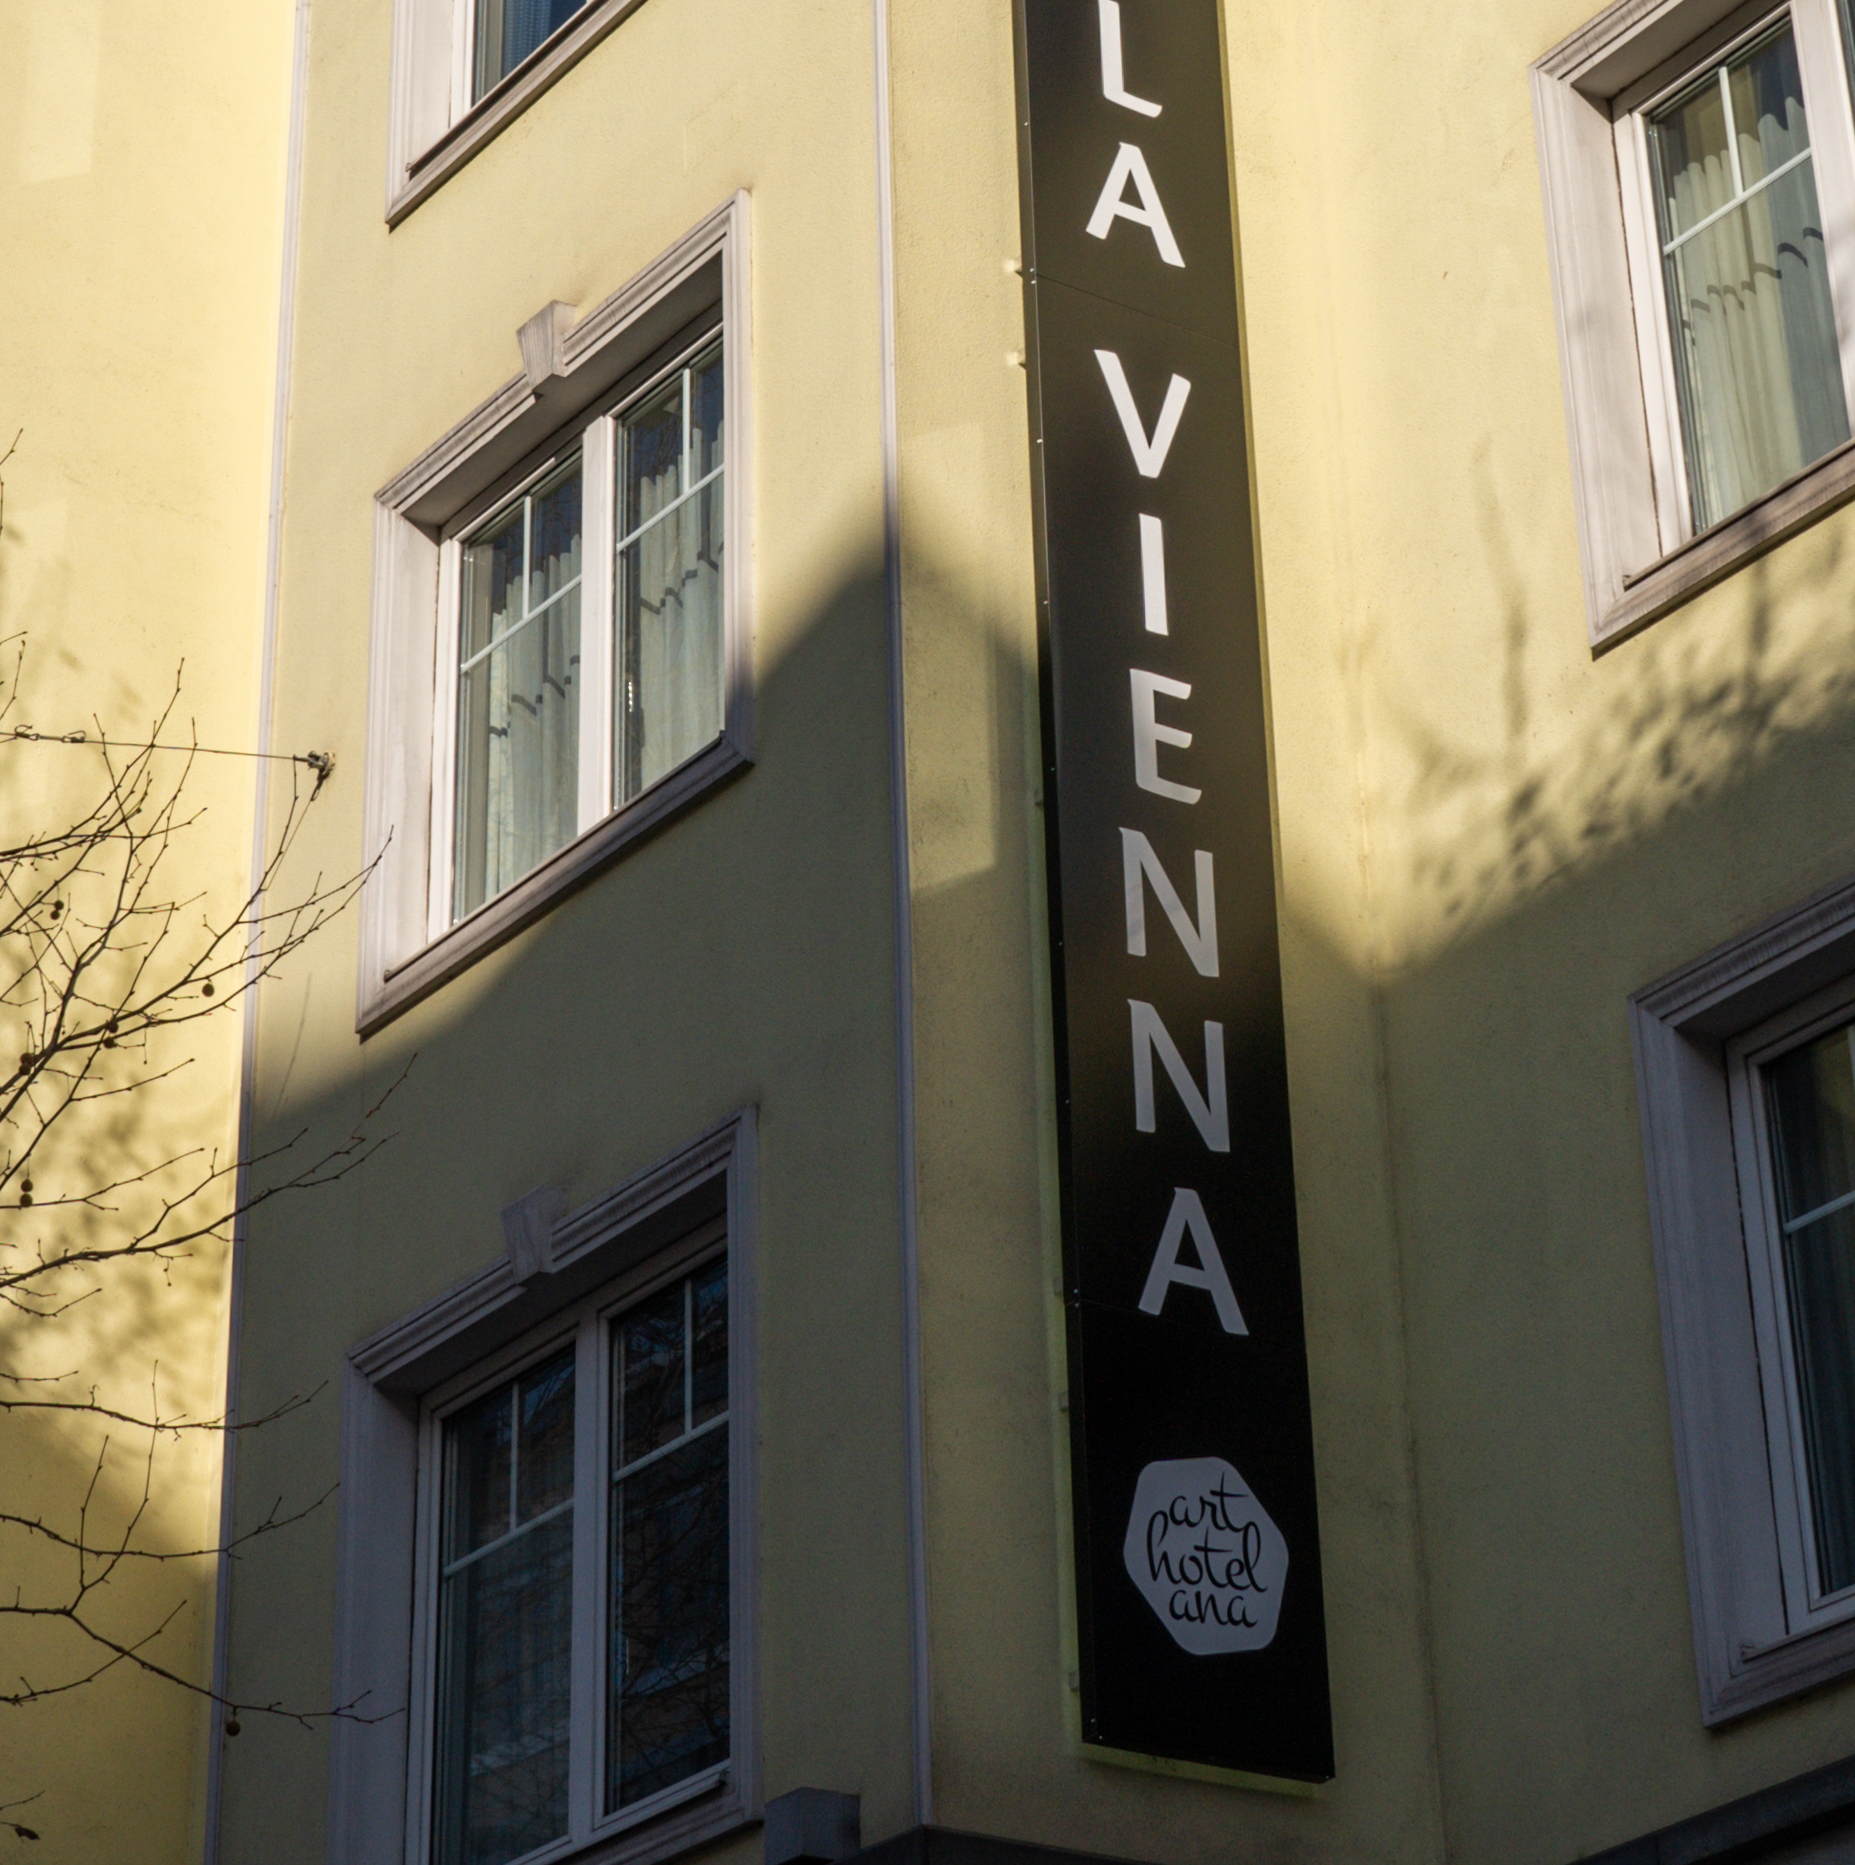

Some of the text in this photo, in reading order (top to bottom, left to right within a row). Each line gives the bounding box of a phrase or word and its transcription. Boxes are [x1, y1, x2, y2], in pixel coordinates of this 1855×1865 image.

[1092, 348, 1250, 1336] VIENNA
[1169, 1470, 1249, 1533] art
[1146, 1509, 1269, 1593] hotel
[1168, 1589, 1259, 1629] ana
